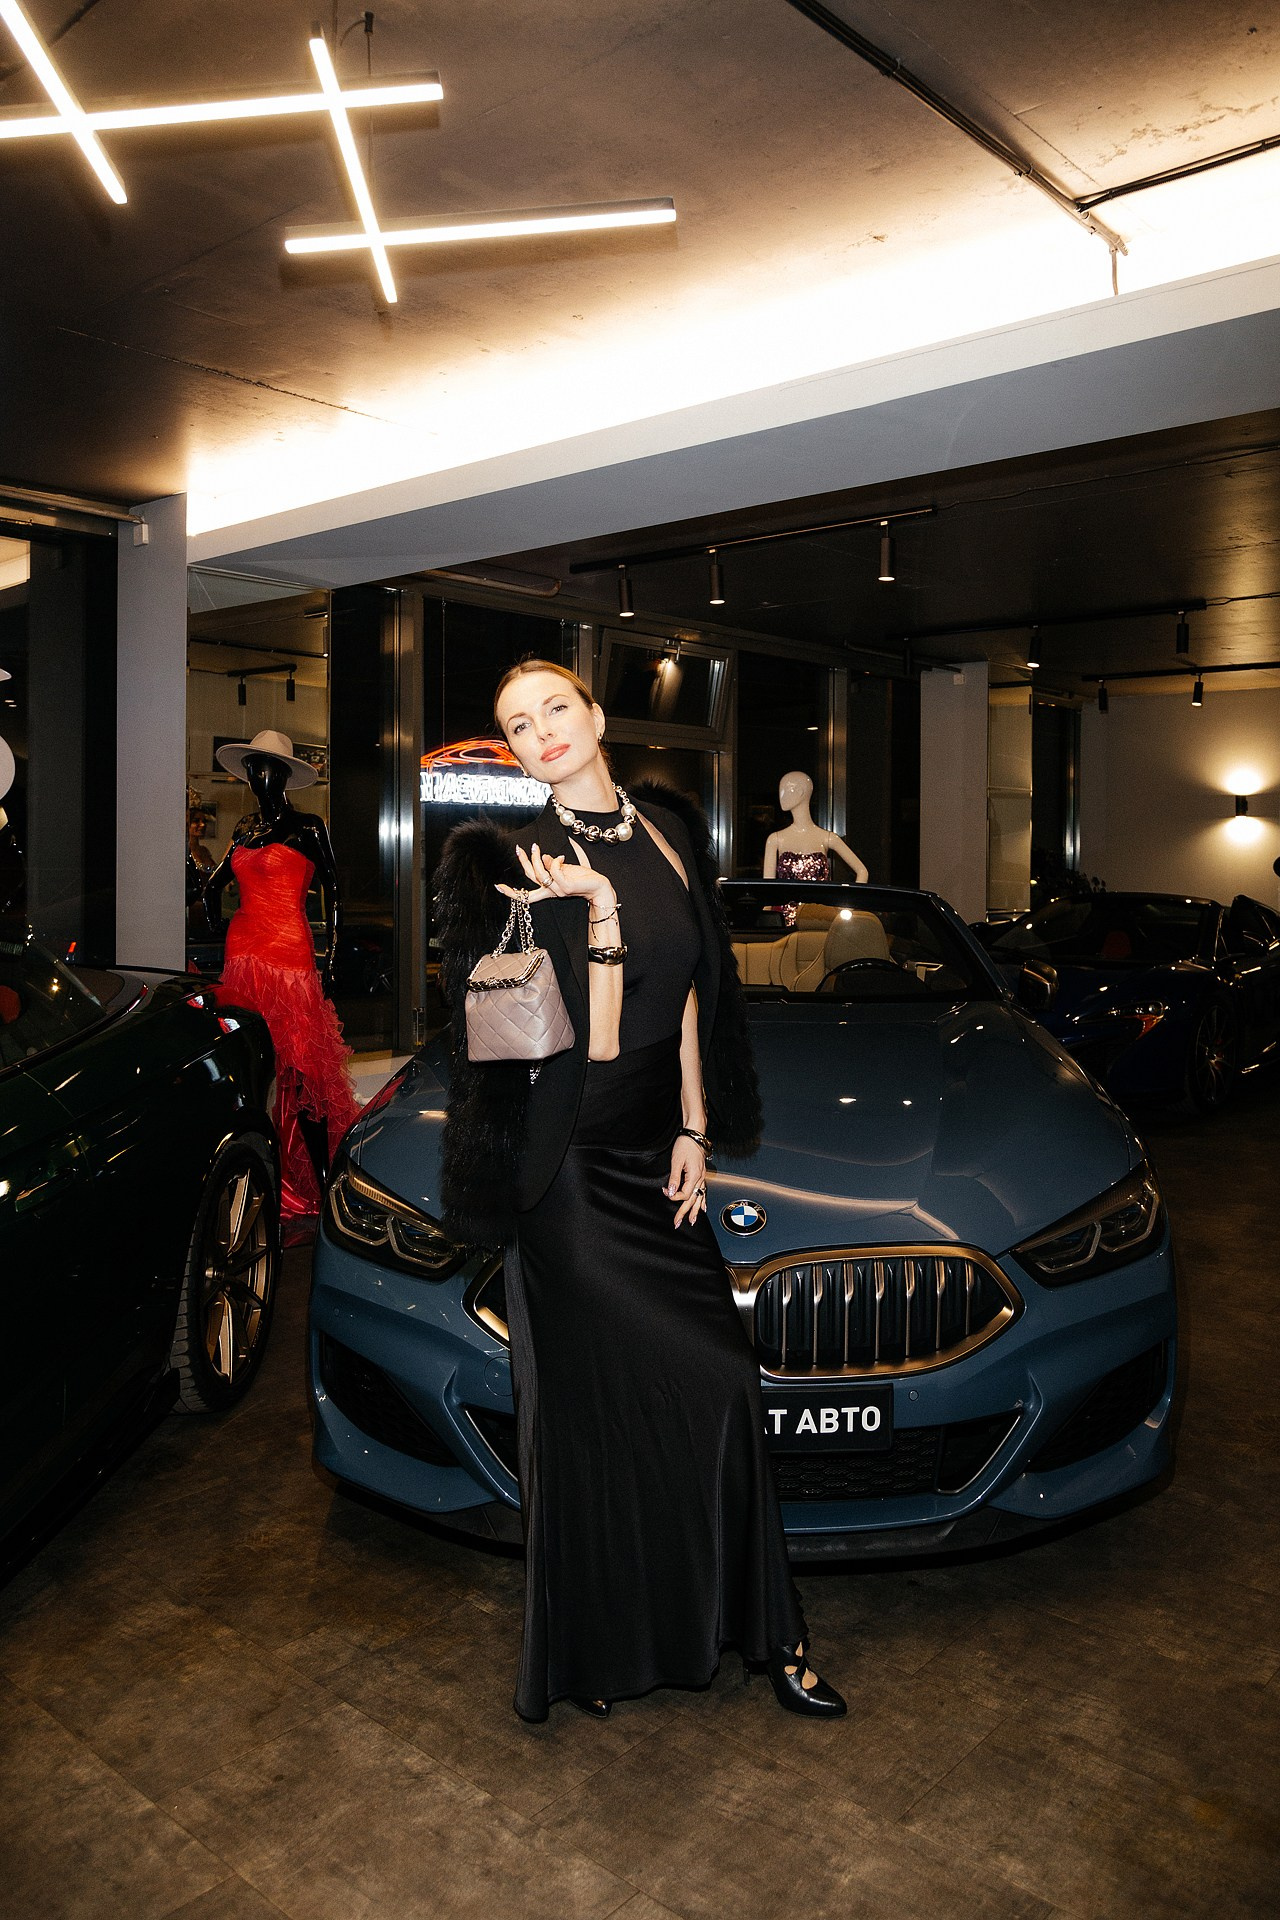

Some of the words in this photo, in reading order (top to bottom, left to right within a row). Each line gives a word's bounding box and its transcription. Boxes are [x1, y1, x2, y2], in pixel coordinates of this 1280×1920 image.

[726, 1201, 763, 1211] BMW
[764, 1409, 787, 1434] Т
[796, 1406, 881, 1434] АВТО
